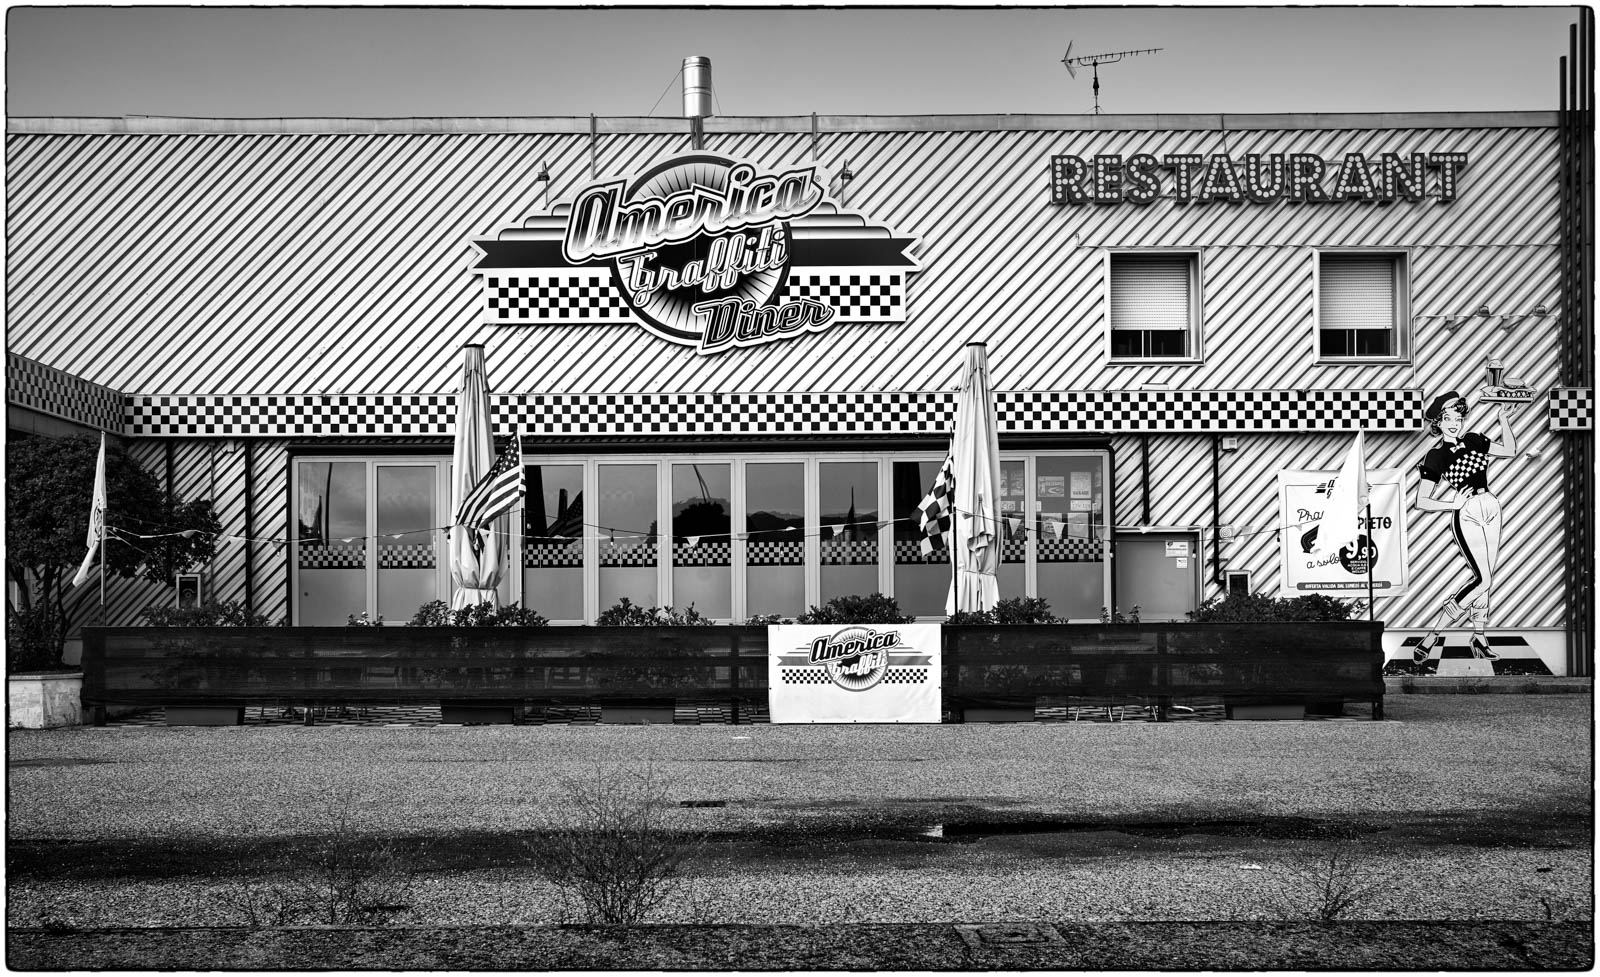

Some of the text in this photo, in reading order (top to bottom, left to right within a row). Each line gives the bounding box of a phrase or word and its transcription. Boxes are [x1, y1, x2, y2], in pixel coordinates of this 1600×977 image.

[1051, 152, 1468, 203] RESTAURANT
[567, 165, 824, 258] America
[620, 225, 789, 307] Graffiti
[699, 299, 834, 350] Diner
[1297, 508, 1324, 522] Pra
[1306, 561, 1315, 569] a
[809, 629, 900, 663] America
